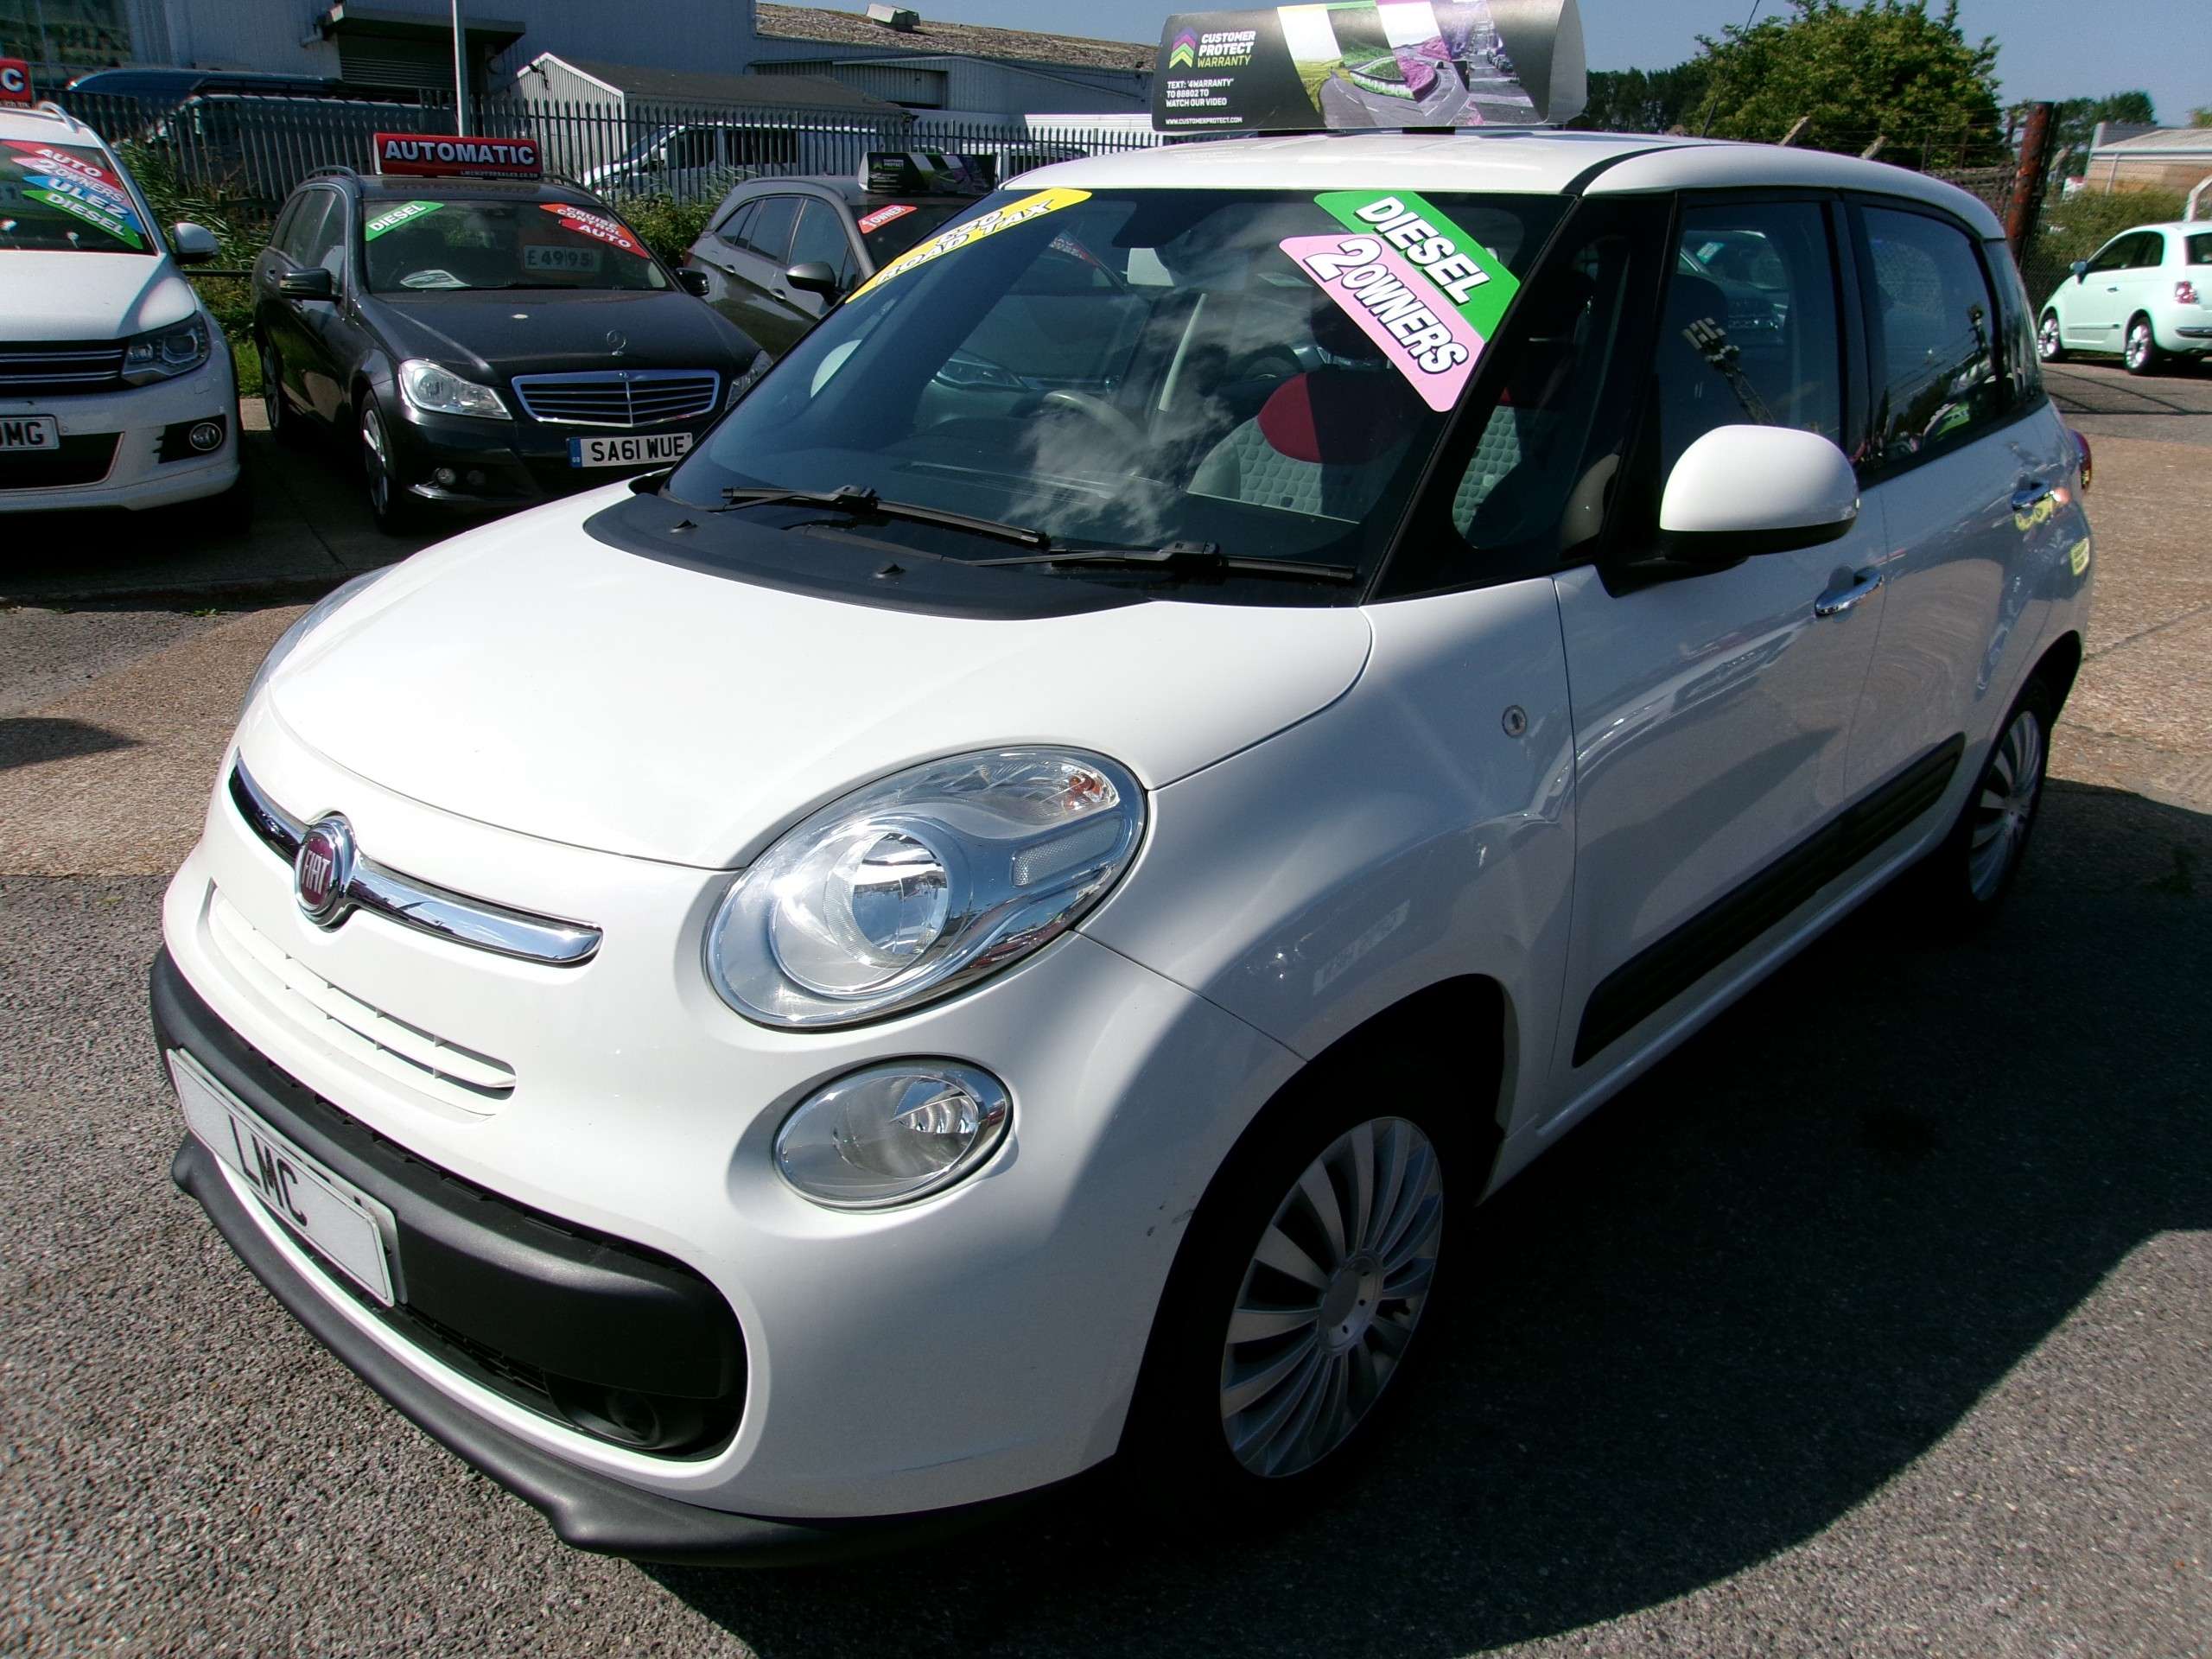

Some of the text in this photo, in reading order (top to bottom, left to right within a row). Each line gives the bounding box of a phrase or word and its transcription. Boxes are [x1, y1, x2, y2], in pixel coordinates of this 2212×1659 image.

[1198, 41, 1254, 56] PROTECT
[1201, 30, 1256, 43] CUSTOMER
[1198, 54, 1251, 68] WARRANTY
[1166, 90, 1176, 99] TO
[1199, 88, 1210, 97] TO
[1167, 80, 1186, 89] TEXT:
[1166, 97, 1227, 107] WATCH OUR VIDEO
[35, 149, 103, 178] AUTO
[385, 141, 536, 165] AUTOMATIC
[48, 178, 130, 220] ULEZ
[47, 193, 124, 237] DIESEL
[368, 204, 427, 232] DIESEL
[557, 208, 623, 238] CONTROL
[567, 207, 619, 230] CRUISE
[579, 225, 632, 248] AUTO
[876, 199, 1056, 284] ROAD TAX
[1353, 196, 1492, 306] DIESEL
[590, 435, 686, 462] SA61 WUE
[302, 849, 332, 896] FIAT
[228, 1114, 308, 1227] LMC
